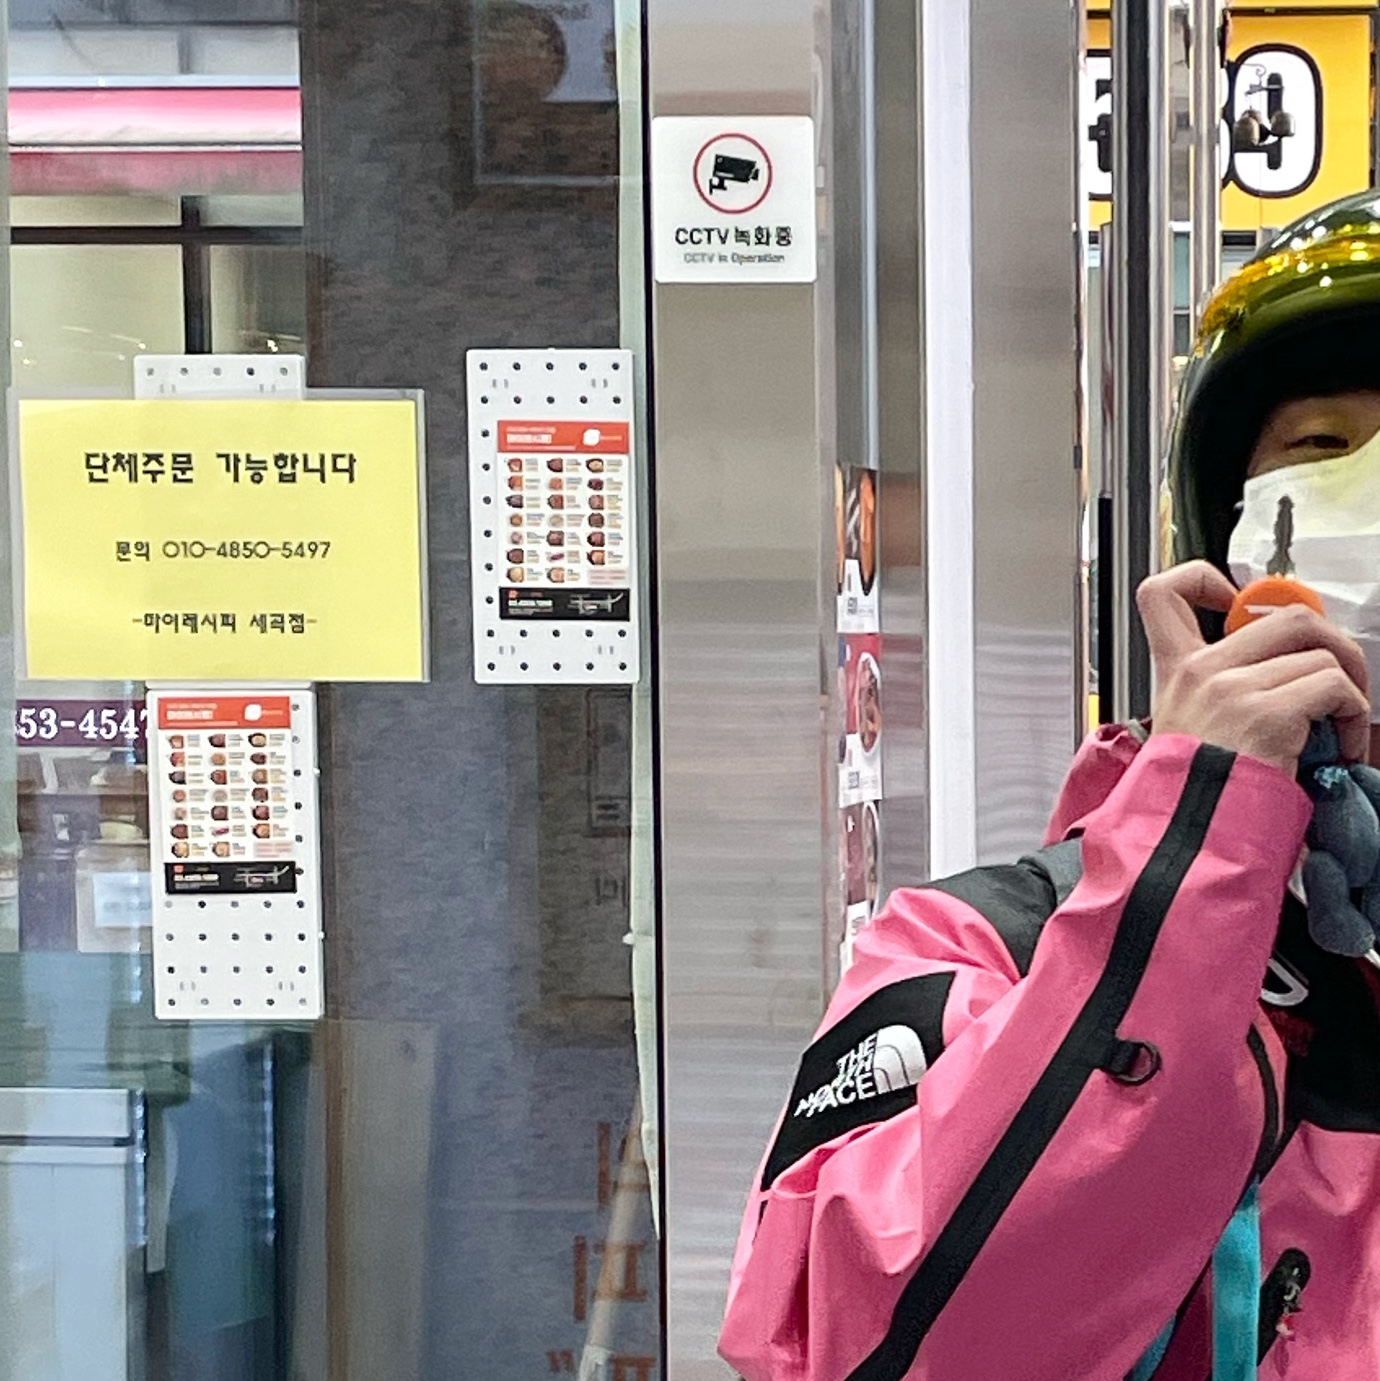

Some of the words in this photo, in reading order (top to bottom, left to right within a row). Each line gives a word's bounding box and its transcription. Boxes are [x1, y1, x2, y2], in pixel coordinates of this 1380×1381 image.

[675, 227, 729, 245] CCTV
[735, 226, 792, 246] 녹화중
[683, 253, 715, 263] CCTV
[85, 452, 194, 484] 단체주문
[216, 452, 356, 484] 가능합니다
[116, 541, 150, 561] 문의
[162, 541, 331, 558] 010-4850-5497
[16, 707, 147, 739] 53-454
